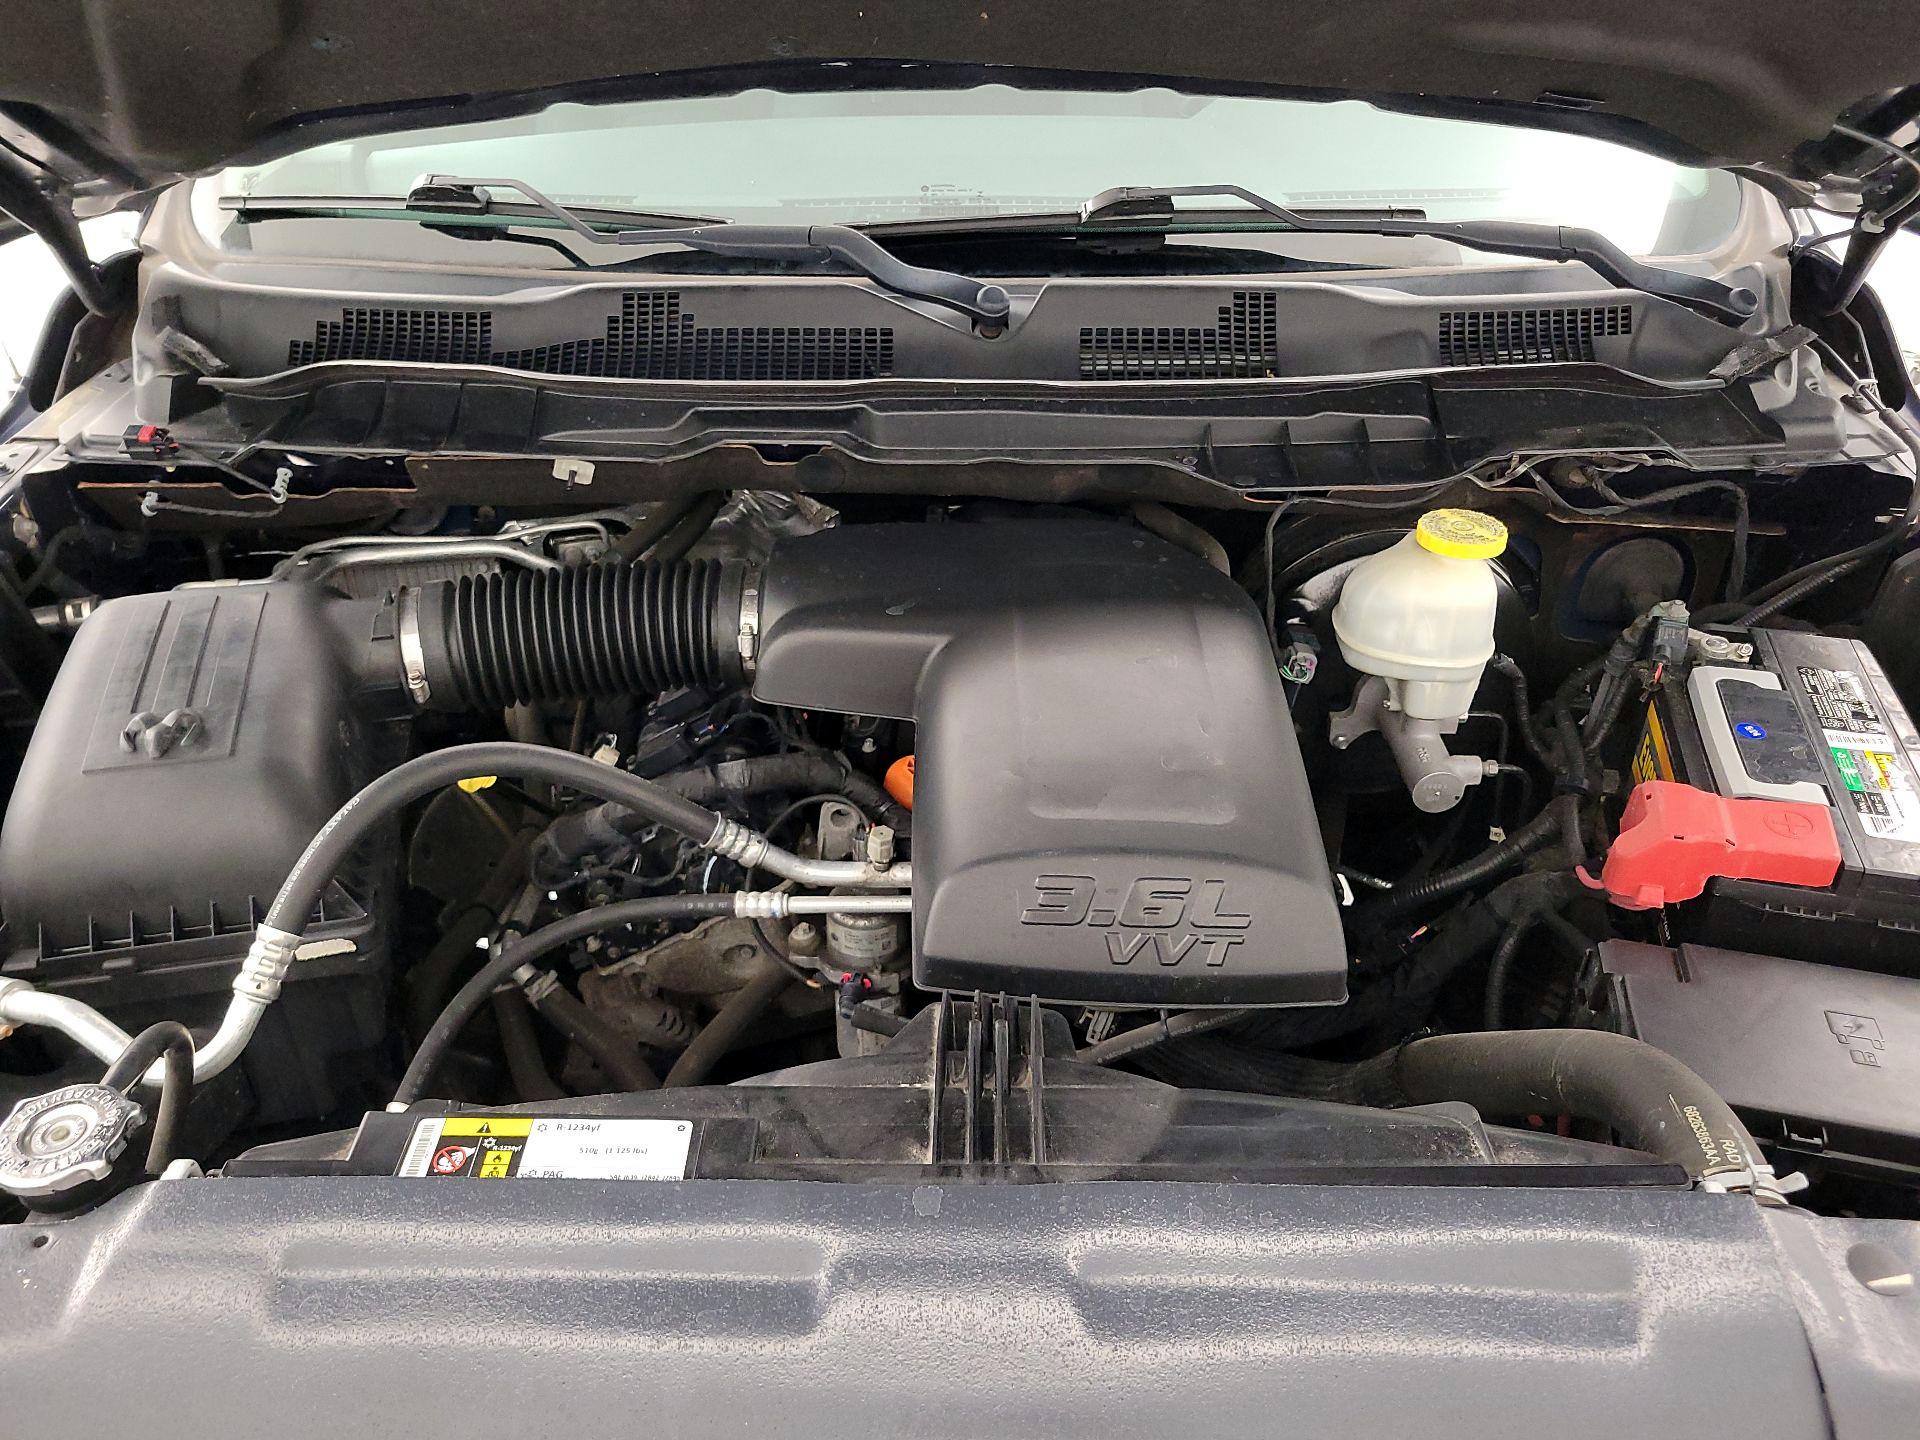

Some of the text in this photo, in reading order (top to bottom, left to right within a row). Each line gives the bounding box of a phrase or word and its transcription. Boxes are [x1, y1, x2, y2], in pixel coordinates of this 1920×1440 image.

[1020, 873, 1252, 929] 3.6L
[1104, 931, 1246, 967] VVT
[52, 1088, 95, 1103] OPEN
[556, 1122, 601, 1133] R-1234yf
[579, 1146, 599, 1155] 510g
[1719, 1138, 1742, 1164] RAD
[542, 1169, 564, 1179] PAG
